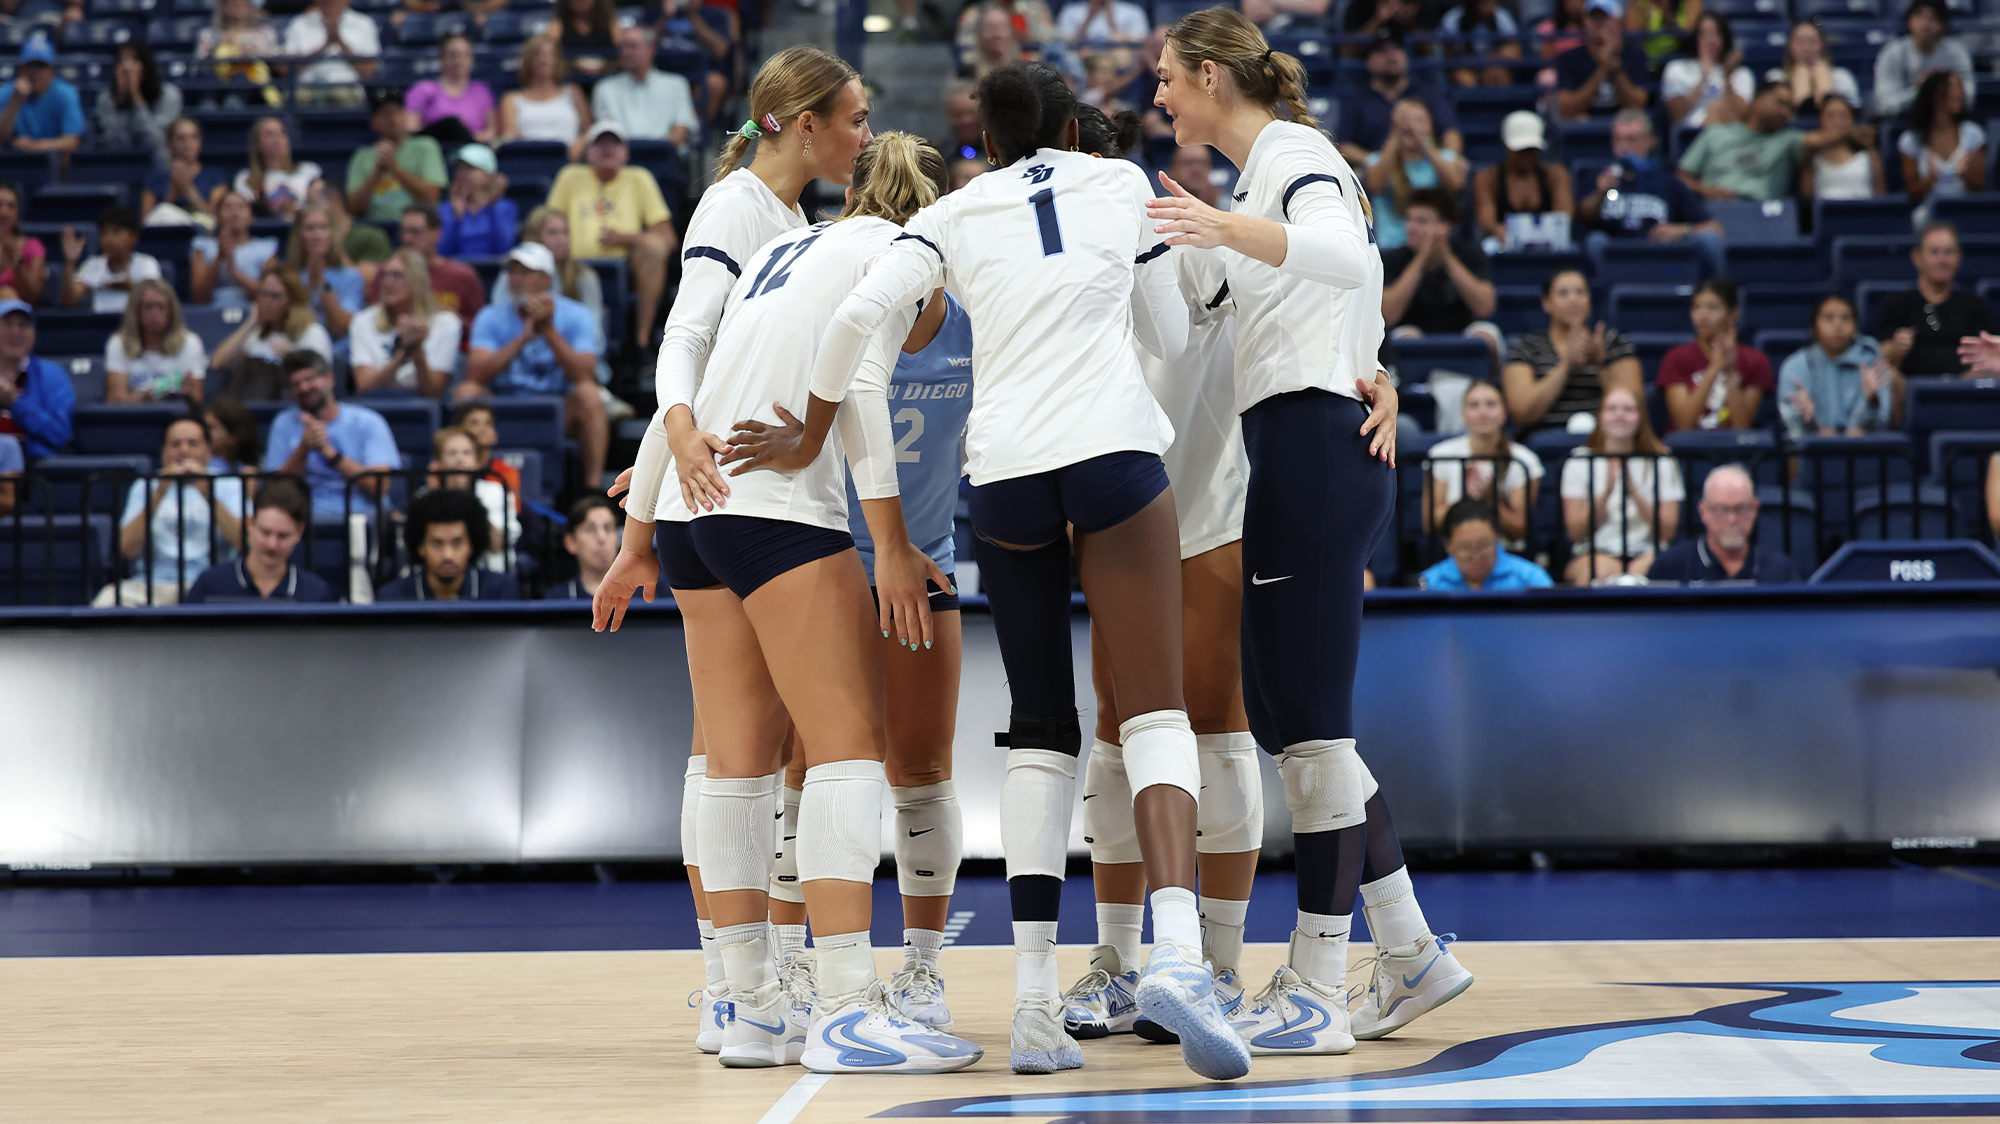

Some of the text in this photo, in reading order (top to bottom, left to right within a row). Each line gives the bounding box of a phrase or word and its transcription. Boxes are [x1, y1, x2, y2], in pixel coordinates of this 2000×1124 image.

[1027, 186, 1066, 259] 1
[743, 233, 824, 301] 12
[902, 382, 968, 400] DIEGO
[893, 408, 925, 463] 2
[1889, 559, 1936, 581] POSS
